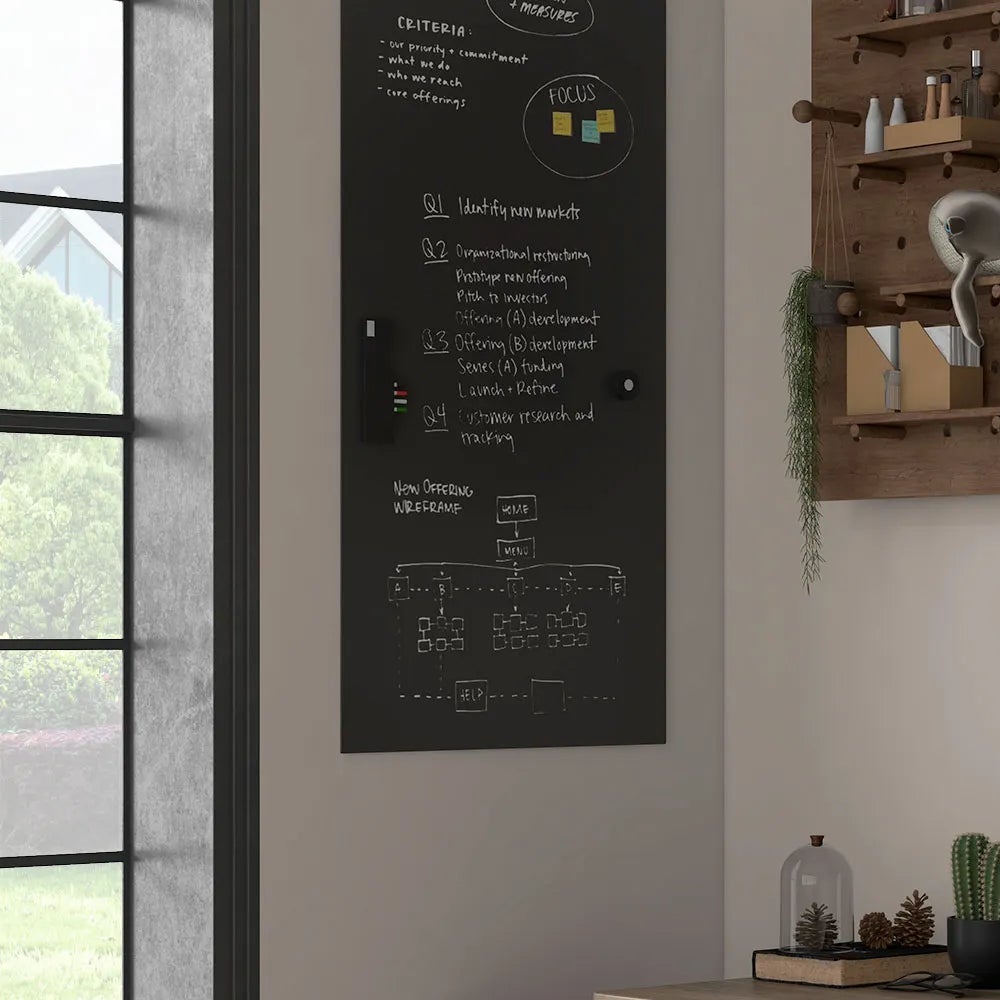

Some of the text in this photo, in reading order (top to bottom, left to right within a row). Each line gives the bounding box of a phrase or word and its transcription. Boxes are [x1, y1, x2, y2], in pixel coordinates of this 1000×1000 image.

[520, 1, 579, 24] MEASURES
[397, 16, 472, 37] CRITERIA:
[388, 54, 450, 71] what we do
[389, 40, 404, 49] our
[408, 43, 445, 58] priority
[459, 49, 528, 65] commitment
[387, 69, 463, 88] who we reach
[386, 89, 466, 110] core offerings
[549, 83, 597, 105] FOCUS
[423, 193, 581, 221] Q1 Identify new markets
[421, 237, 592, 267] Q2 Organizational restructuring
[456, 268, 568, 290] Prototype new offering
[457, 289, 485, 303] Pitch
[489, 291, 499, 304] to
[506, 308, 526, 328] (A)
[529, 309, 600, 327] development
[422, 328, 598, 356] Q3 Offering (B) development
[457, 357, 564, 378] Series (A) funding
[458, 381, 506, 398] Launch
[517, 379, 559, 396] Refine
[423, 403, 447, 427] Q4
[519, 404, 571, 424] research
[575, 402, 594, 422] and
[423, 478, 474, 498] OFFERING
[393, 500, 462, 515] WIREFRAME
[504, 546, 529, 556] MENU
